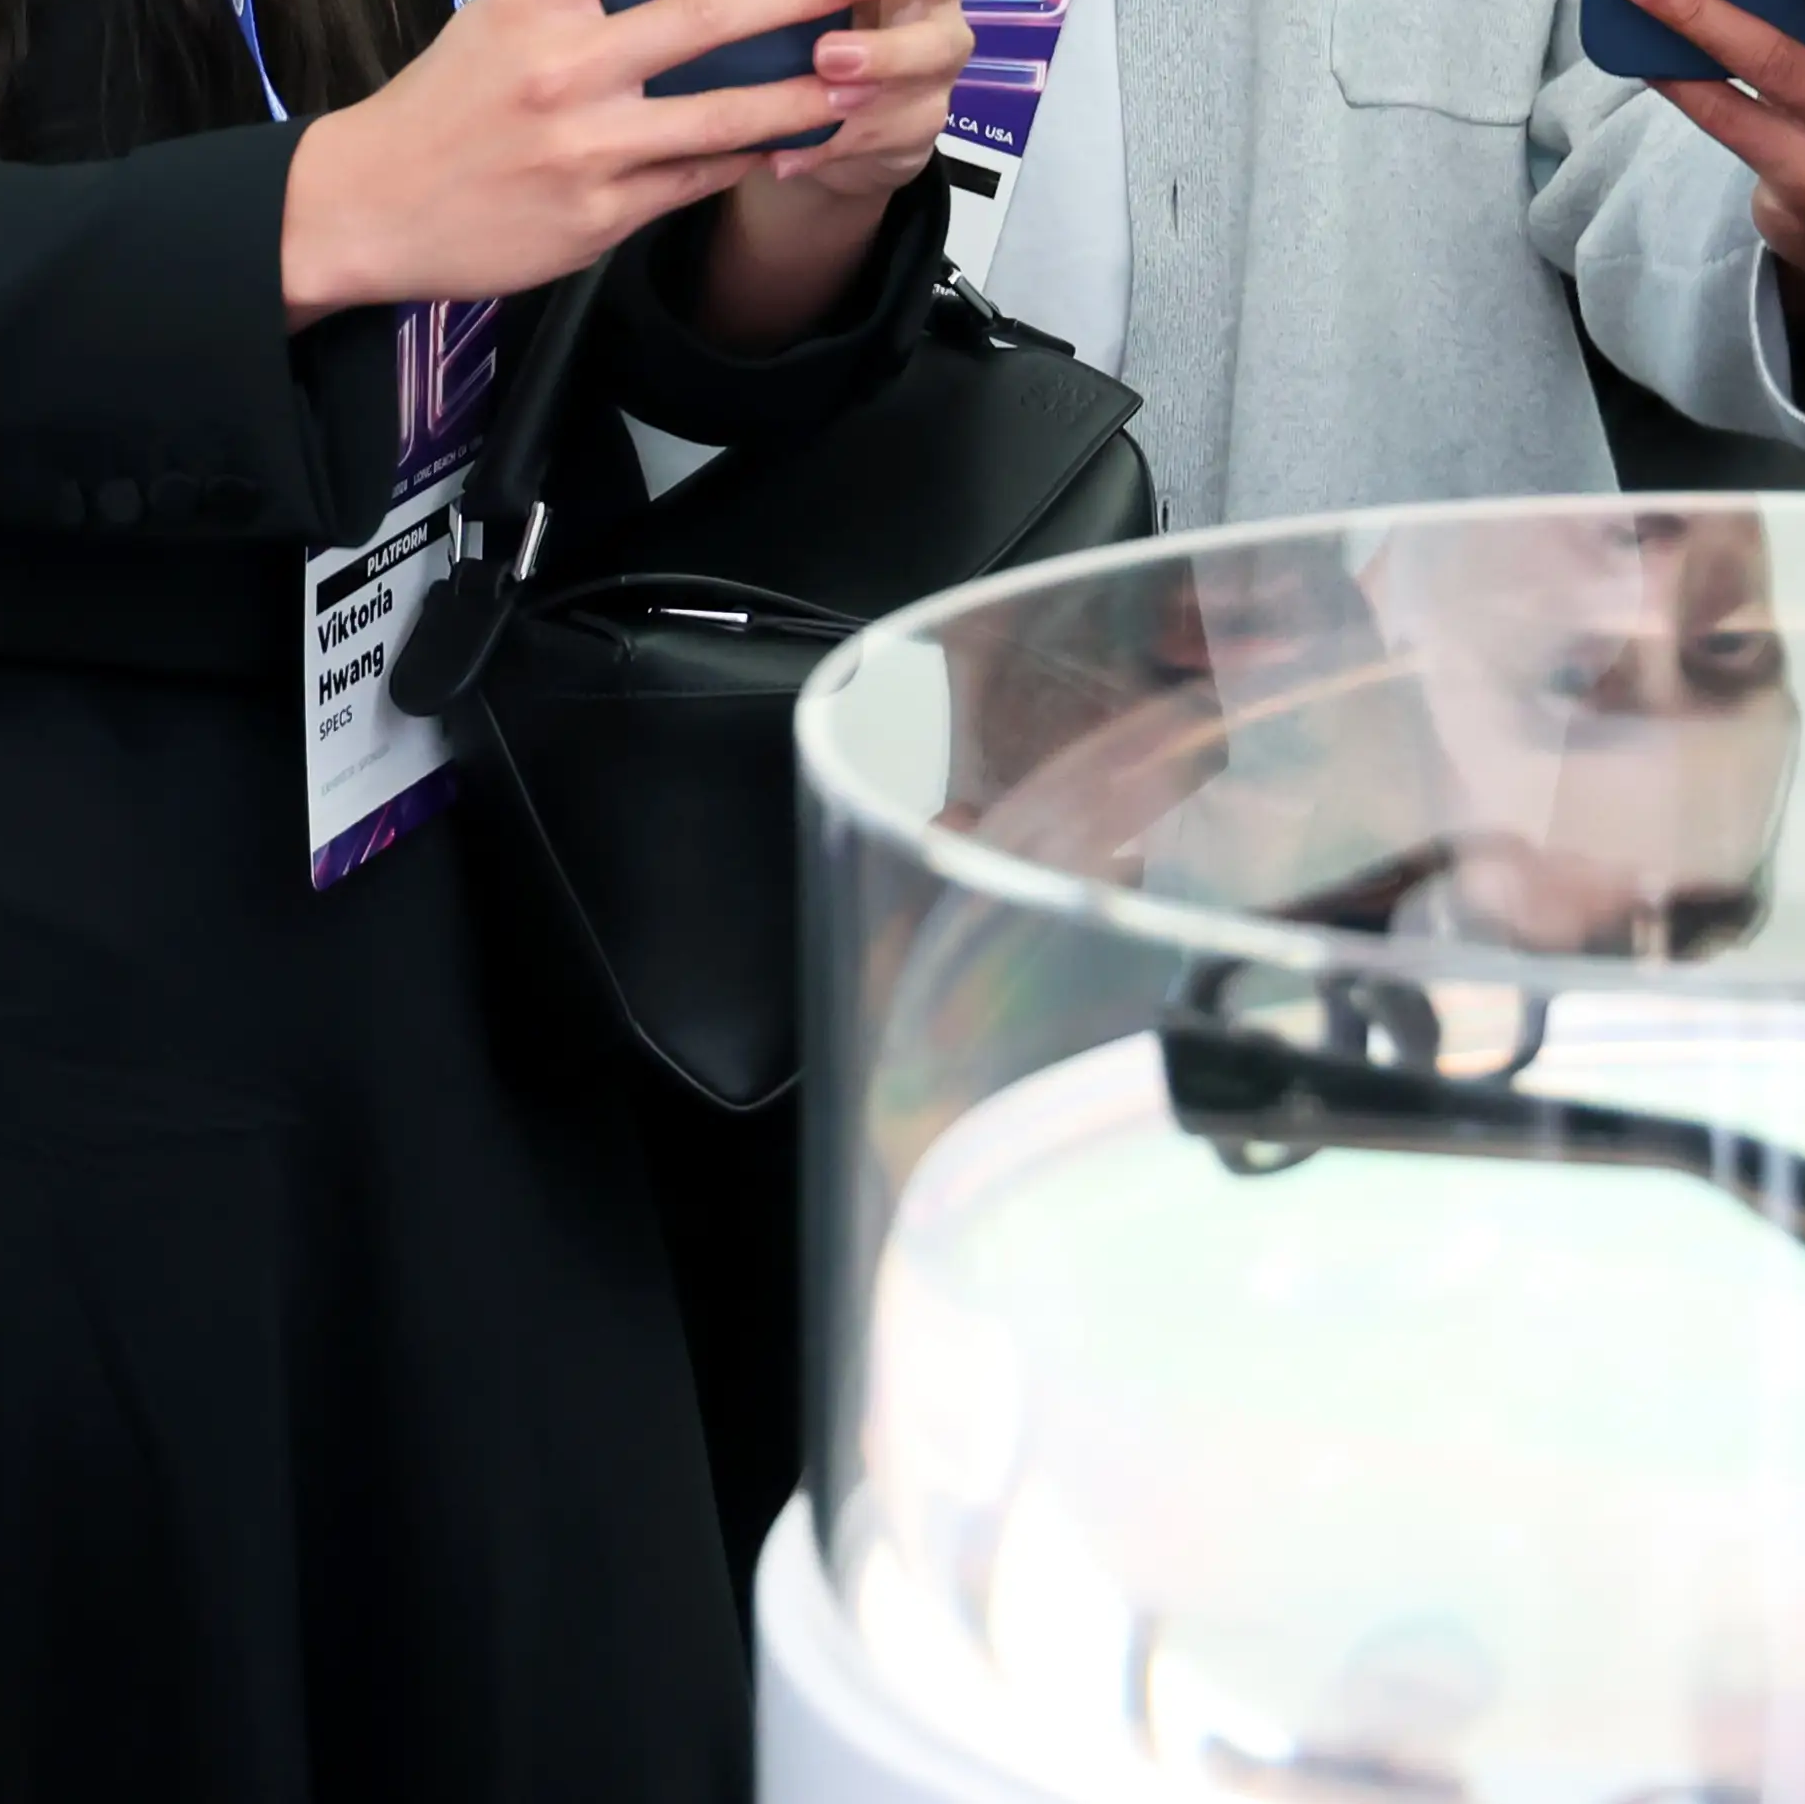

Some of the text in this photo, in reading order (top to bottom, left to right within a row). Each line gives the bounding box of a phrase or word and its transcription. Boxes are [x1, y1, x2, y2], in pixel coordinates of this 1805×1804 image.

[959, 116, 978, 135] CA
[985, 124, 1014, 146] USA
[367, 522, 428, 578] PLATFORM
[317, 581, 393, 655] Viktoria
[318, 640, 385, 707] Hwang
[319, 704, 353, 741] SPECS
